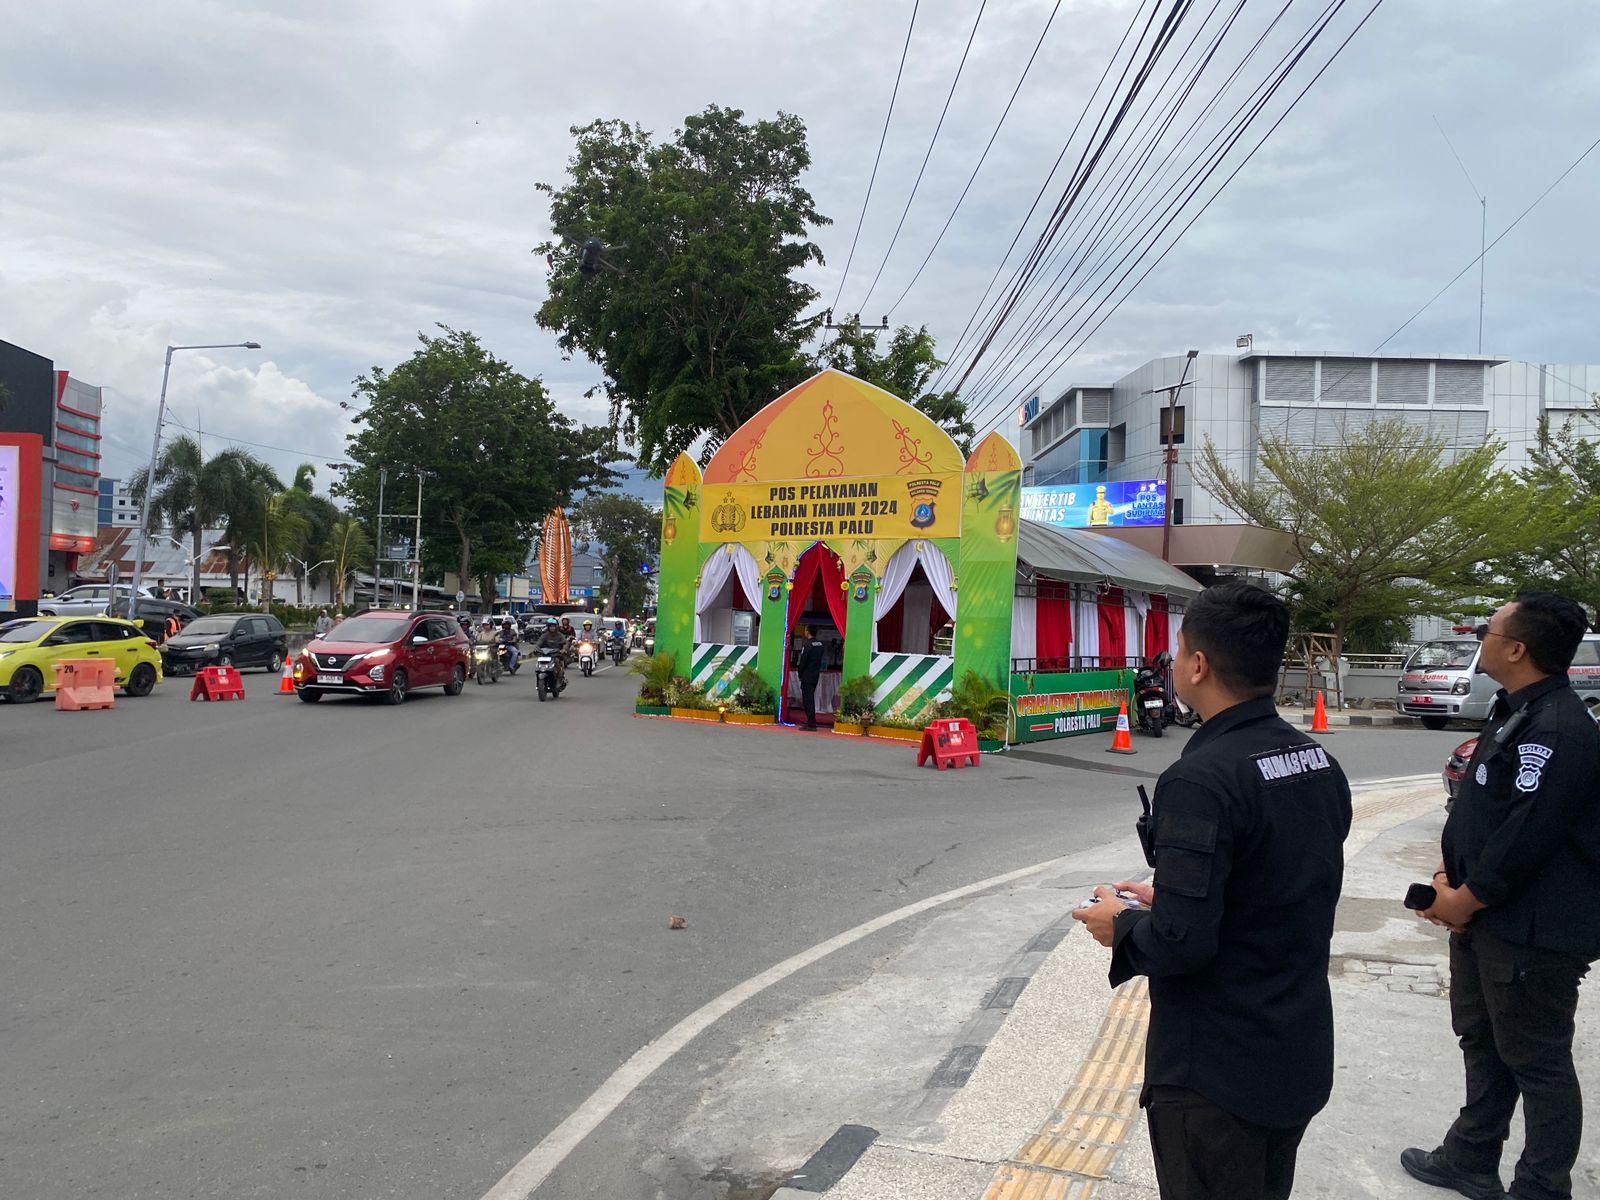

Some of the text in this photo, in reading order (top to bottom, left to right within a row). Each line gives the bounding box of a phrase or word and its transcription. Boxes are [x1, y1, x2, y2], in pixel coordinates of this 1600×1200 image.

[769, 482, 878, 501] POS PELAYANAN
[1037, 492, 1076, 507] TERTIB
[751, 500, 898, 519] LEBARAN TAHUN 2024
[770, 519, 874, 536] POLRESTA PALU
[1017, 694, 1048, 717] OPERASI
[1054, 714, 1101, 733] POLRESTA PALU
[1520, 745, 1549, 757] POLDA
[1256, 752, 1301, 780] HUMAS
